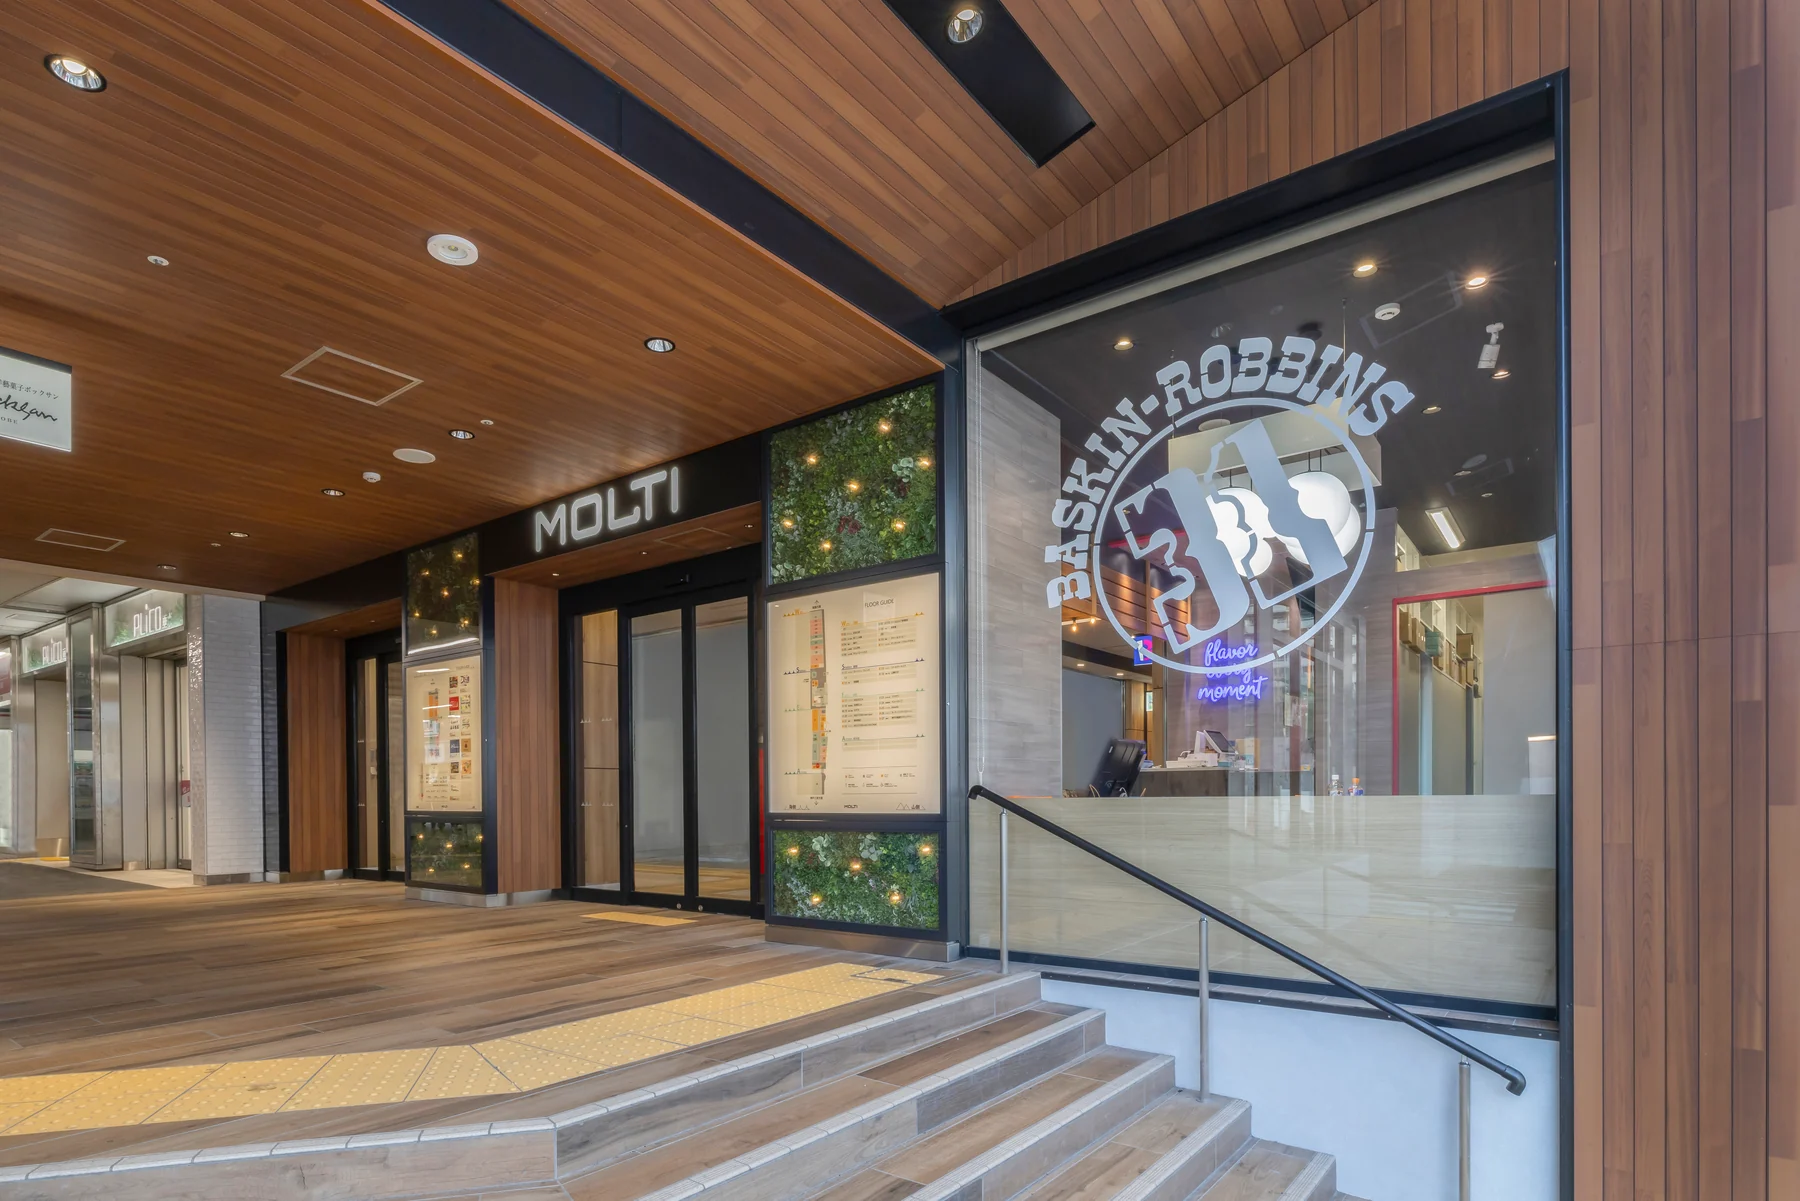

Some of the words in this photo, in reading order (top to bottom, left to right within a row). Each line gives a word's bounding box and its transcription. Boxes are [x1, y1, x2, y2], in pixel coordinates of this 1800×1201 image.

[1045, 336, 1415, 608] BASKIN-ROBBINS
[535, 466, 679, 552] MOLTI
[1114, 418, 1348, 654] 31
[864, 601, 879, 609] FLOOR
[880, 598, 895, 606] GUIDE
[1205, 639, 1258, 666] flavor
[1198, 676, 1268, 702] moment
